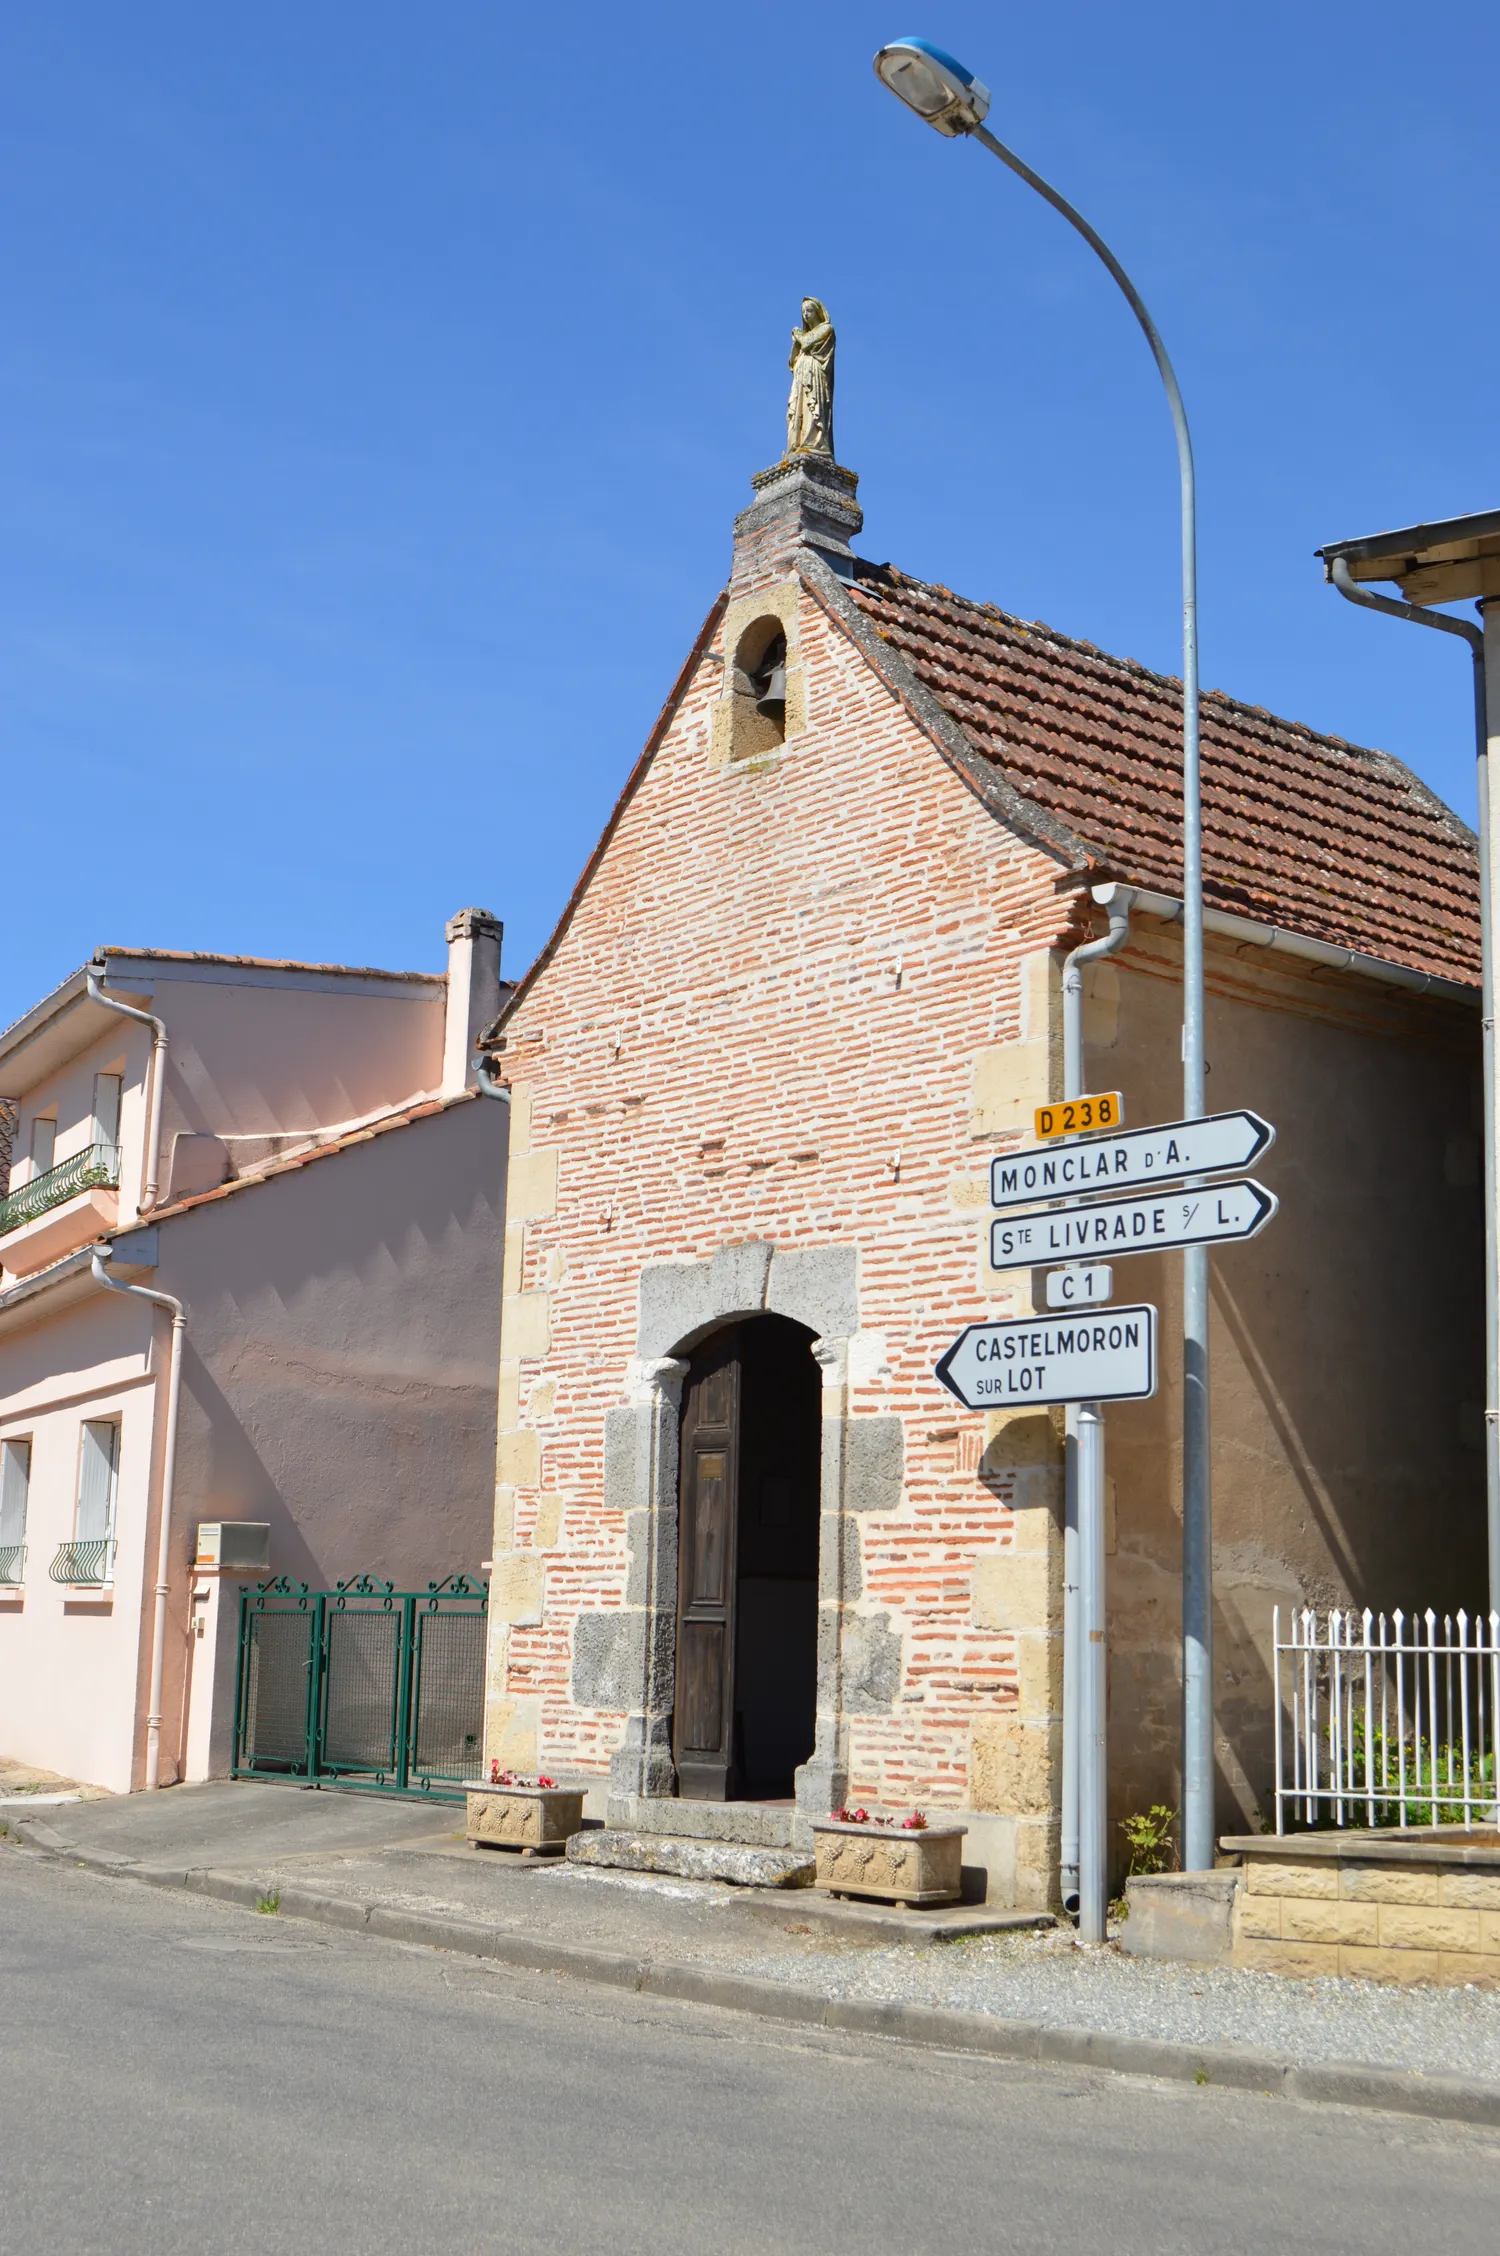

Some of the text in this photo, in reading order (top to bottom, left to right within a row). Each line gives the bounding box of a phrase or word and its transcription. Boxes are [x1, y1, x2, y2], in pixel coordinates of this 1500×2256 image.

[1041, 1099, 1111, 1134] D 238
[1001, 1149, 1128, 1193] MONCLAR
[1050, 1208, 1165, 1248] LIVRADE
[1062, 1273, 1093, 1299] C 1
[976, 1323, 1139, 1362] CASTELMORON
[976, 1366, 1046, 1395] SUR LOT
